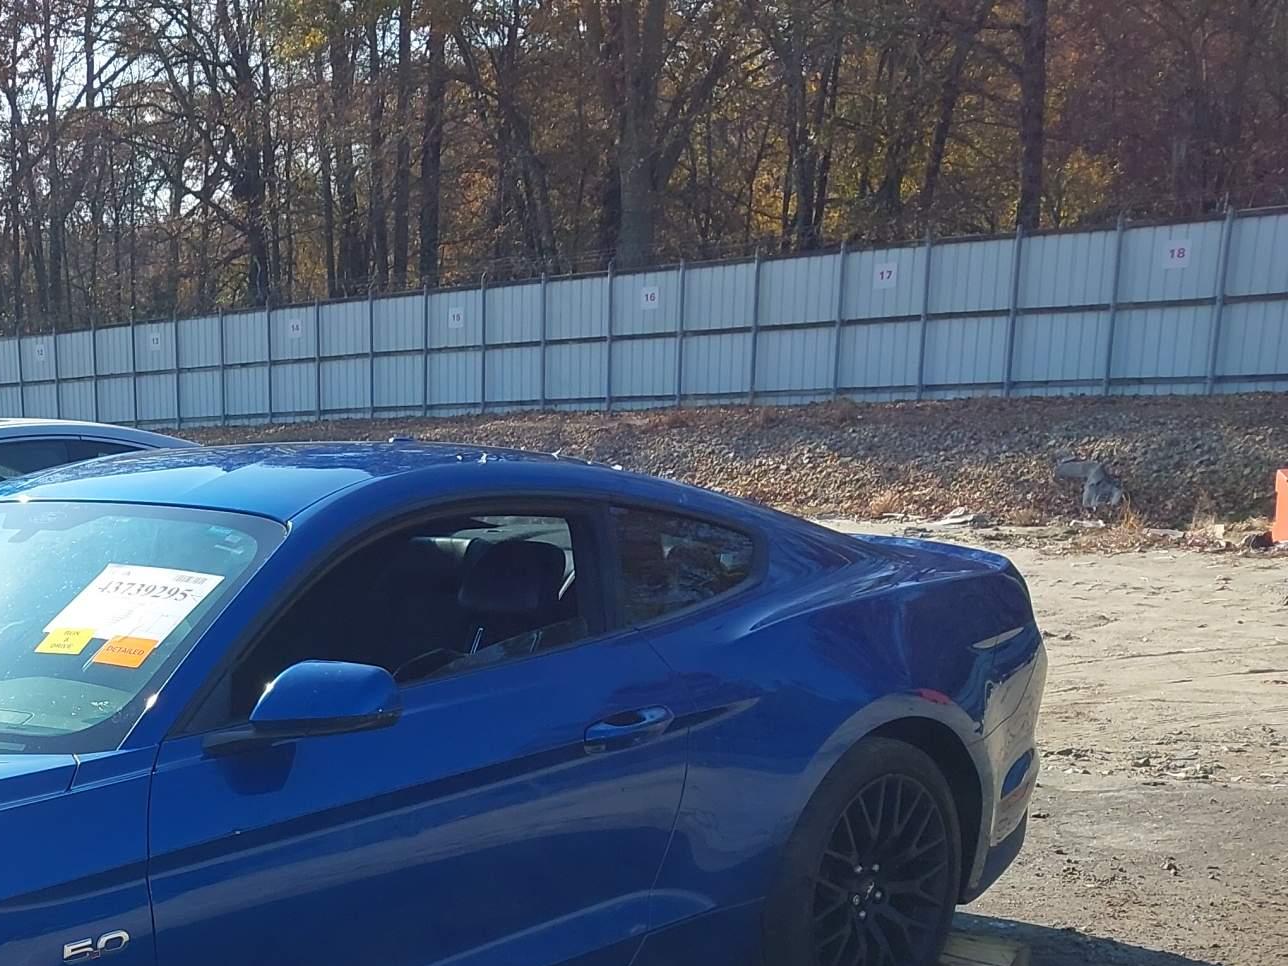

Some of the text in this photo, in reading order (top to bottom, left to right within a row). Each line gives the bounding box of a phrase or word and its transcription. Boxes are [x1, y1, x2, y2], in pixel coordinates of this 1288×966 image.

[1169, 247, 1186, 259] 18
[879, 270, 893, 281] 17
[644, 292, 656, 302] 16
[98, 580, 192, 602] 43739295
[106, 645, 145, 656] DETAILED
[63, 929, 130, 962] 5.0
